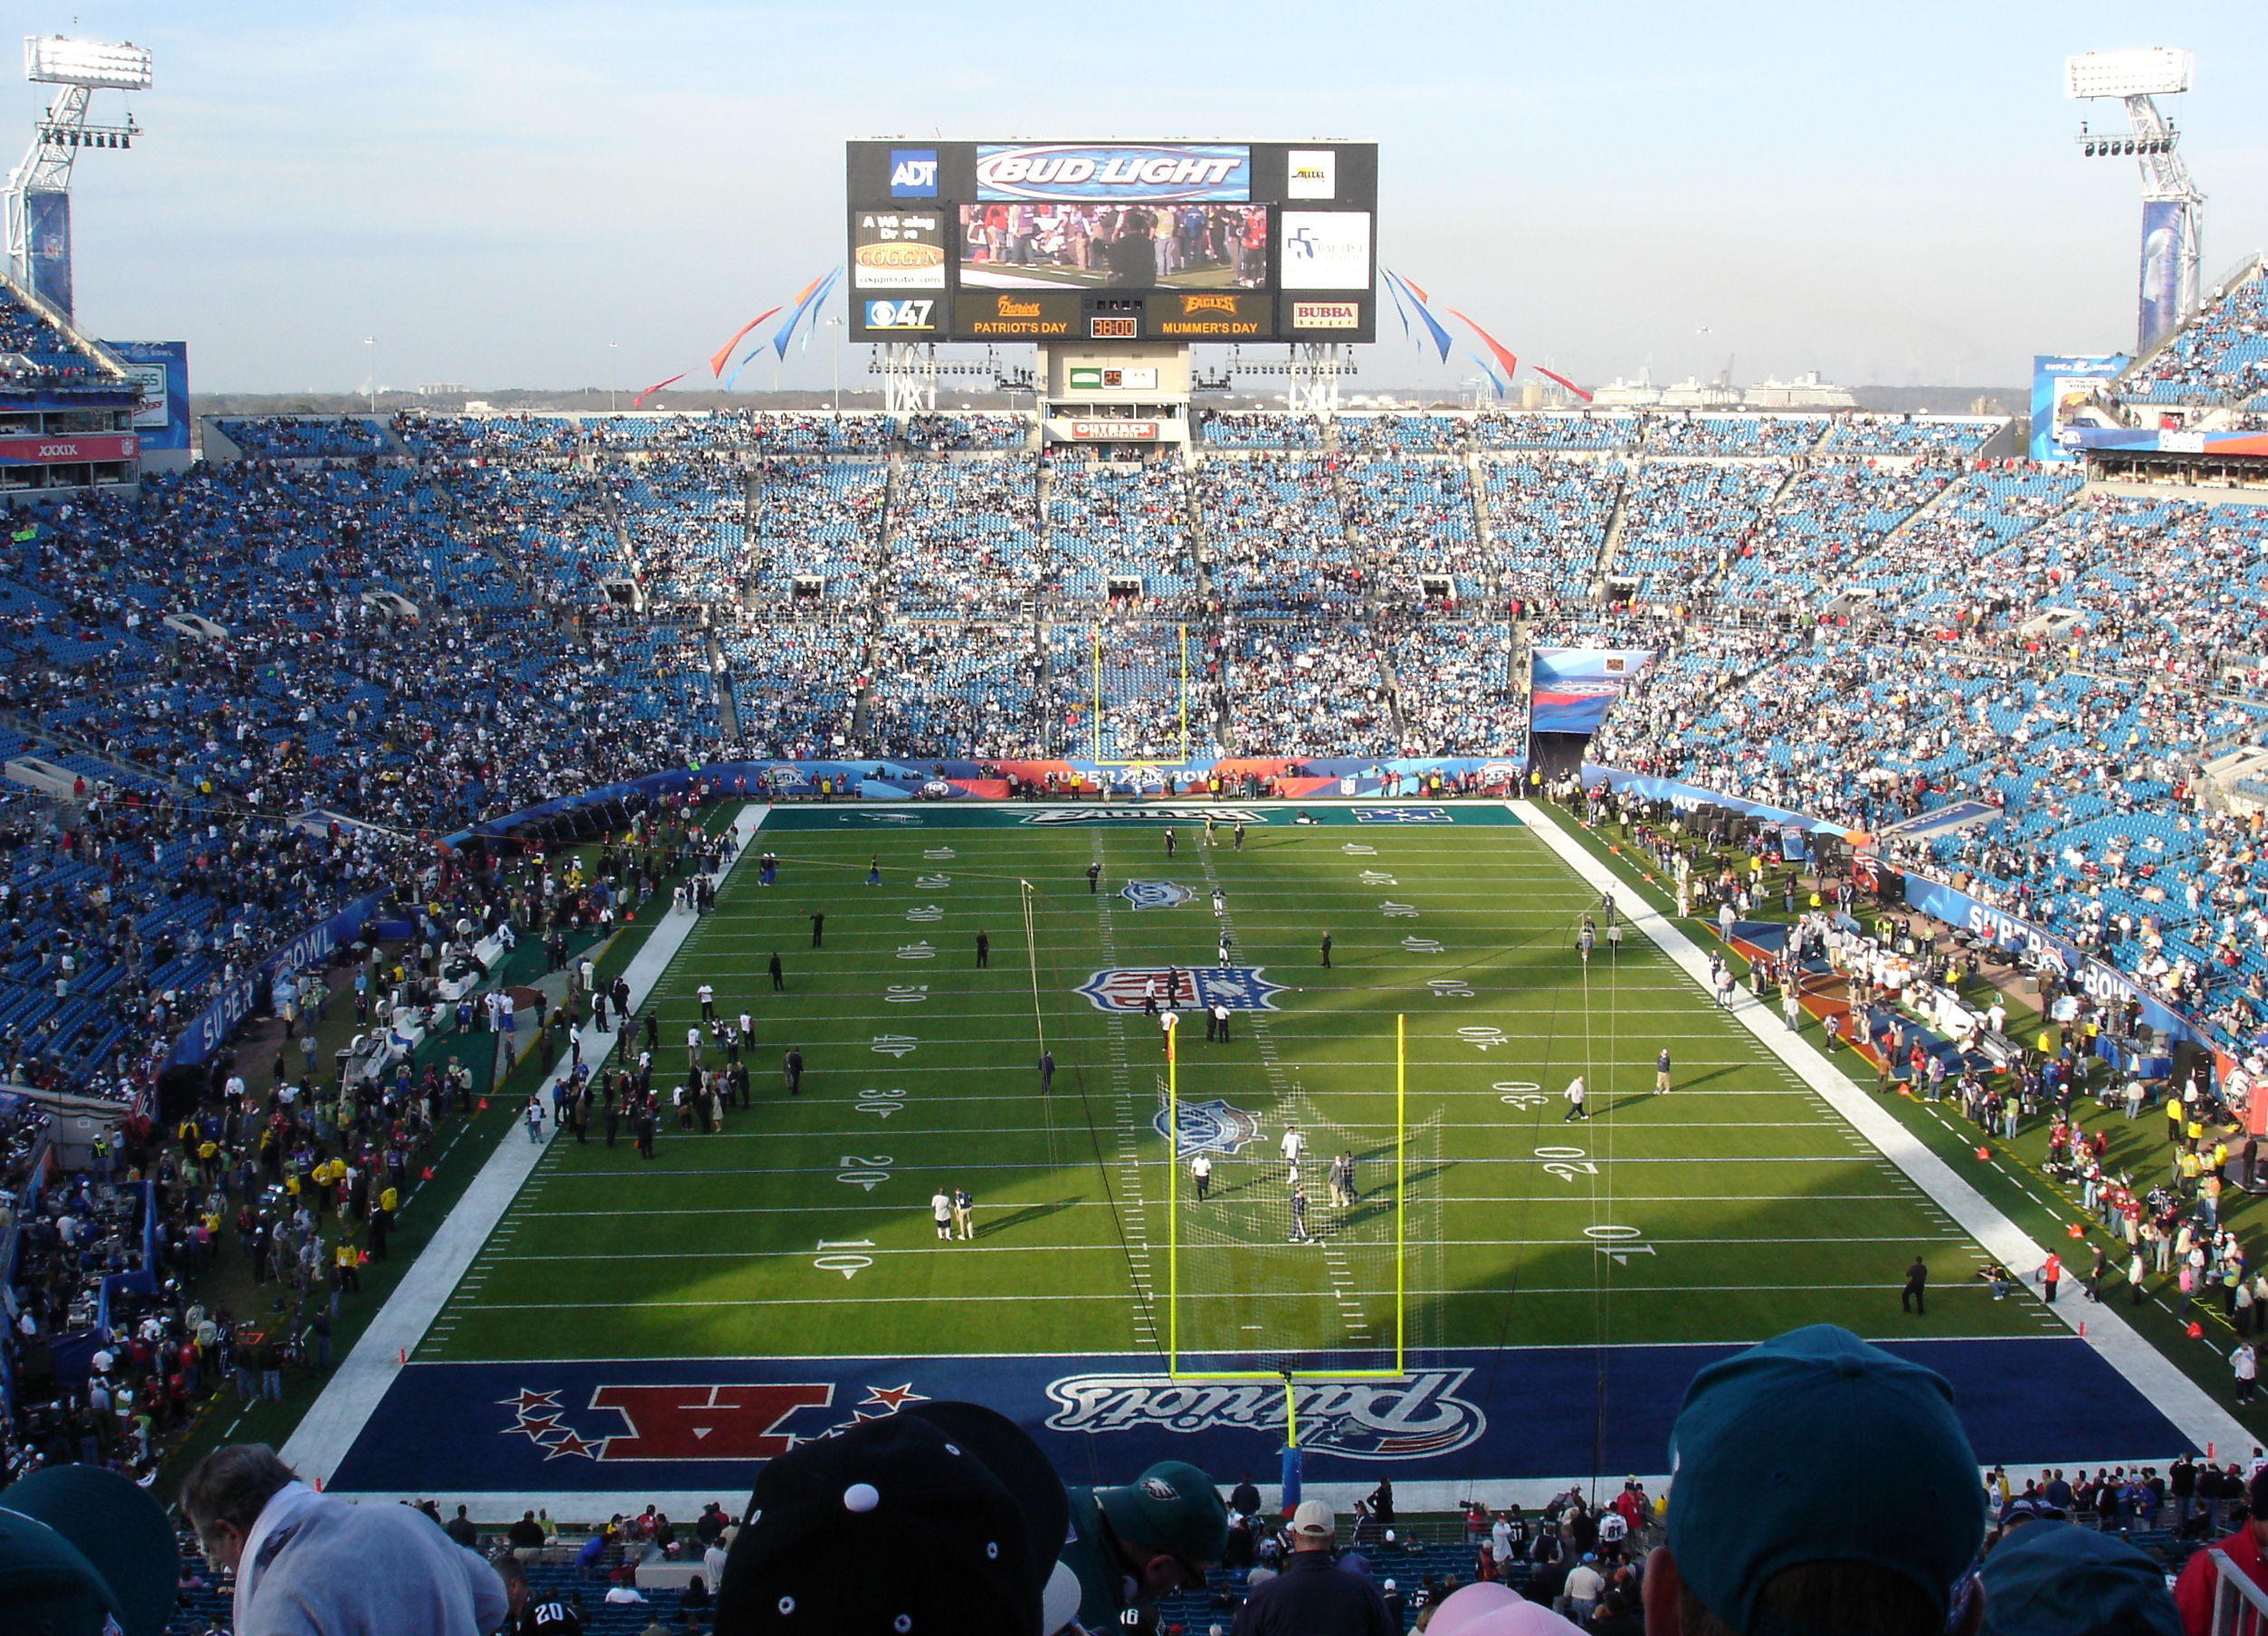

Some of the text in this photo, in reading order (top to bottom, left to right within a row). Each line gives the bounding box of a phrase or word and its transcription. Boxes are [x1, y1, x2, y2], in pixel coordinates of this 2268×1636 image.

[891, 160, 938, 186] ADT
[991, 157, 1241, 185] BUD LIGHT
[862, 215, 935, 231] A Wining
[858, 250, 938, 266] COGGIN
[1186, 296, 1235, 312] EAGLES
[895, 300, 934, 326] 47
[1298, 307, 1353, 318] BUBBA
[974, 322, 1067, 334] PATRIOT'S DAY
[1093, 319, 1134, 336] 38:00
[1162, 322, 1258, 334] MUMMER'S DAY
[2044, 363, 2117, 371] SUPER BOWL
[1104, 371, 1121, 385] 25
[1076, 423, 1150, 434] OUTBACK
[38, 444, 78, 456] XXXIX
[1043, 770, 1116, 784] SUPER
[1173, 770, 1216, 783] BOW
[2084, 965, 2134, 1003] BOW
[204, 980, 254, 1051] SUPER
[1045, 1368, 1487, 1451] Patriots
[535, 1603, 564, 1625] 20
